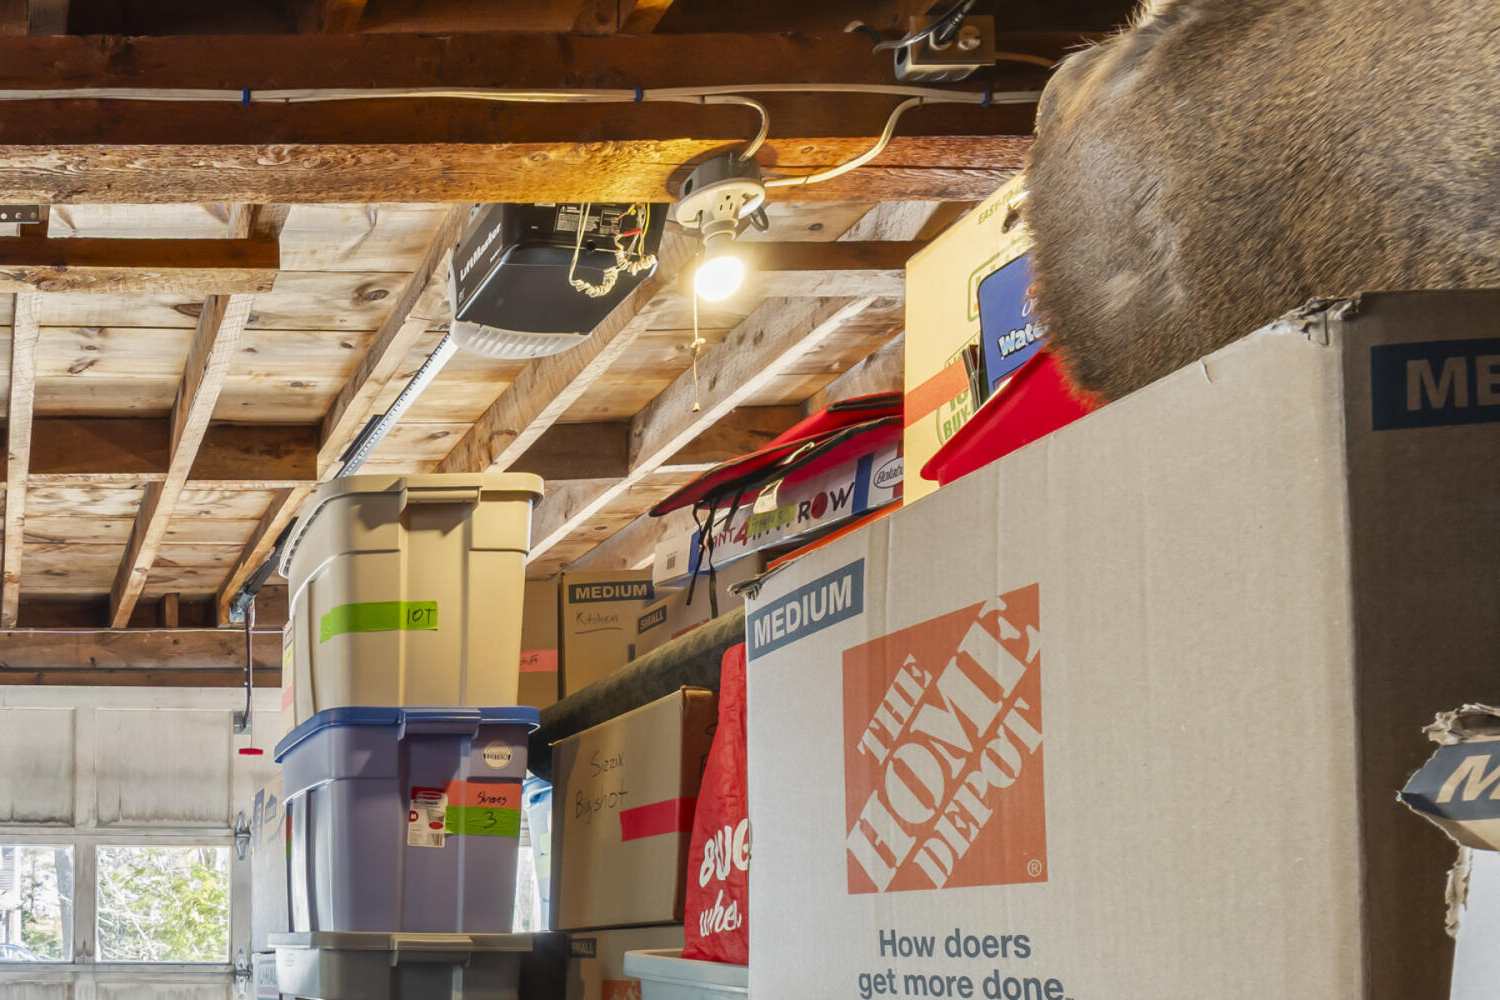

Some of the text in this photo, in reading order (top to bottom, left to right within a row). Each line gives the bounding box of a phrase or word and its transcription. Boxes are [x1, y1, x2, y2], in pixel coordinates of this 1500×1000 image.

[575, 583, 648, 600] MEDIUM
[639, 608, 665, 630] SMALL
[754, 575, 852, 649] MEDIUM
[857, 653, 933, 765] THE
[846, 596, 1041, 893] HOME
[913, 697, 1043, 889] DEPOT
[483, 811, 498, 829] 3
[879, 928, 1032, 959] How doers
[858, 968, 898, 1000] get
[904, 974, 974, 998] more
